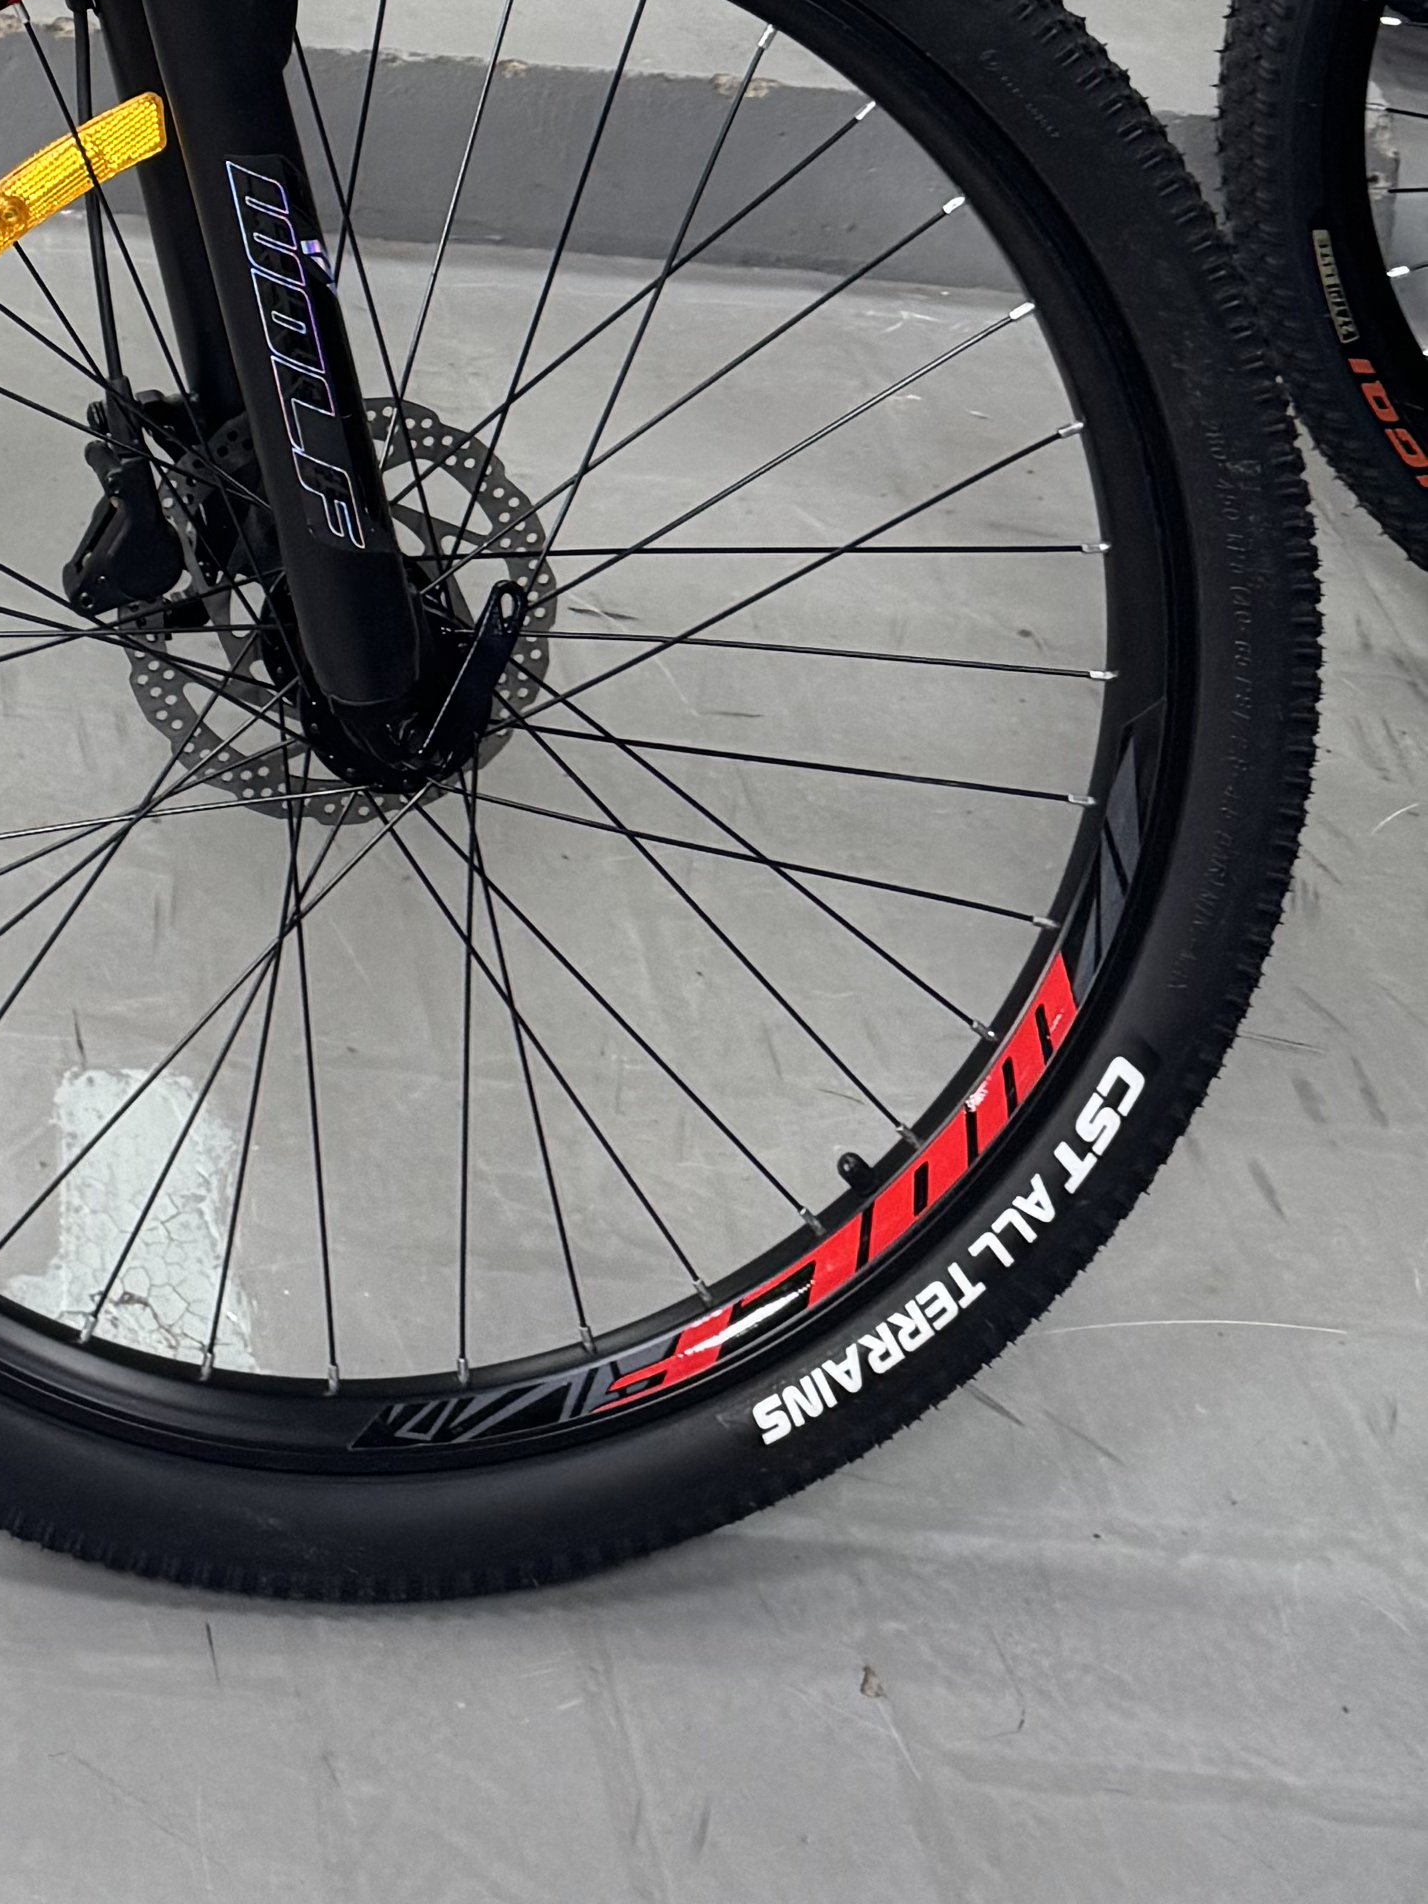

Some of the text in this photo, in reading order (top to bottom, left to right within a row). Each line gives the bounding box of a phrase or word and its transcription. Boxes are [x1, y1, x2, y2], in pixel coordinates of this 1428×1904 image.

[224, 159, 366, 550] WOLF
[591, 949, 1079, 1415] WOLF
[751, 1055, 1146, 1446] CST ALL TERRAINS
